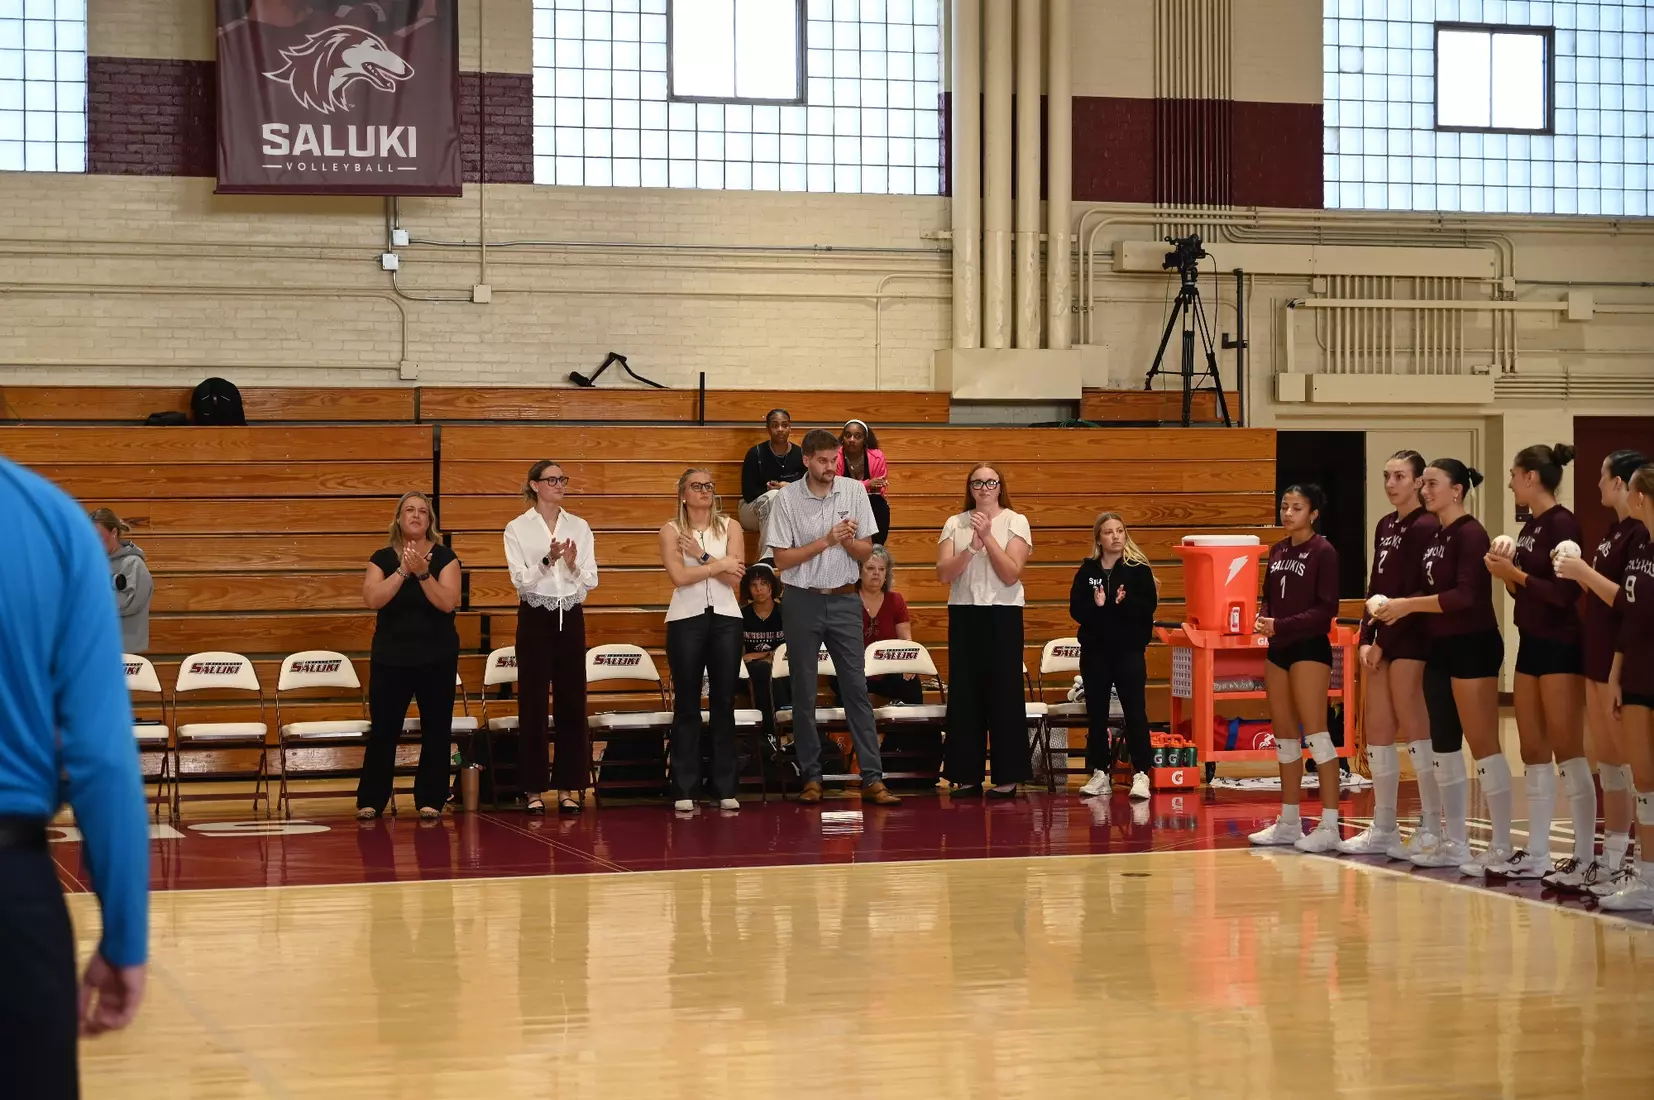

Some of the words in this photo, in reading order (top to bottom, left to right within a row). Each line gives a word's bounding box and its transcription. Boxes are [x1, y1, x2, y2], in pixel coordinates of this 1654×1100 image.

[261, 123, 417, 158] SALUKI
[286, 162, 394, 173] VOLLEYBALL
[1270, 559, 1306, 577] SALUKIS
[1378, 550, 1389, 574] 2
[1280, 575, 1287, 599] 1
[1625, 575, 1637, 603] 9
[289, 660, 342, 673] SALUKI
[1154, 754, 1163, 764] G
[1168, 753, 1178, 764] G
[1171, 770, 1184, 785] G
